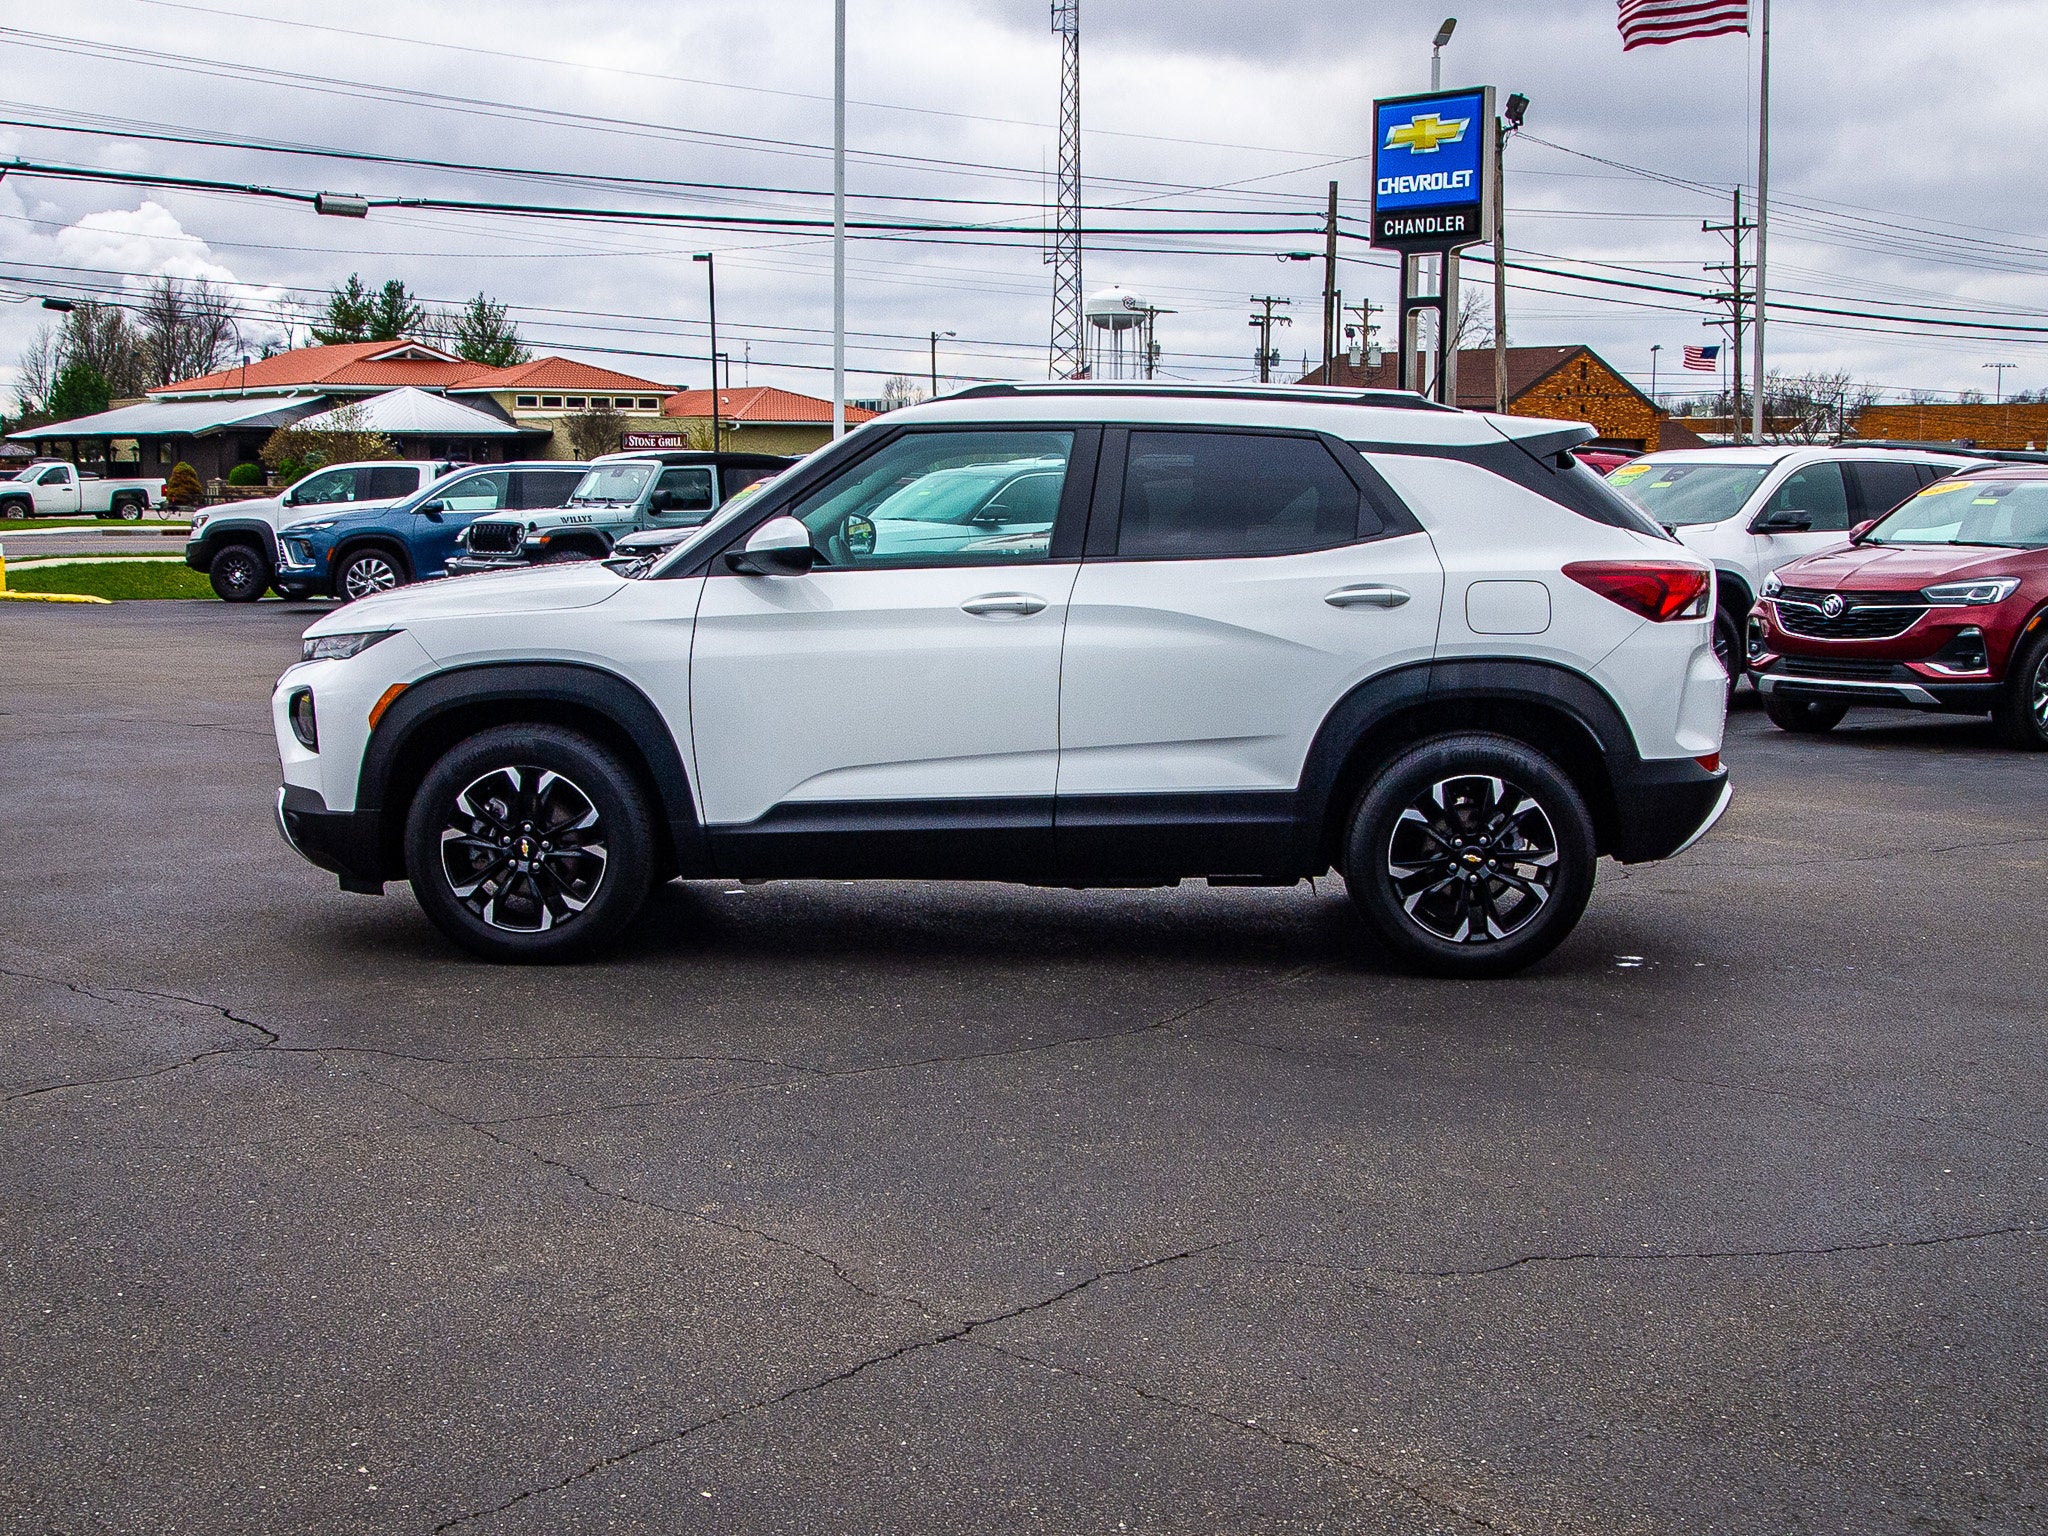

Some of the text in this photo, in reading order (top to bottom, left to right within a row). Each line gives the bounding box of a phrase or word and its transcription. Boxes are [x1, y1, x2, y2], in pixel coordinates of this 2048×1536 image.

[1377, 169, 1474, 195] CHEVROLET
[1384, 215, 1465, 236] CHANDLER
[628, 435, 683, 447] STONE GRILL
[560, 514, 593, 524] WILLYS
